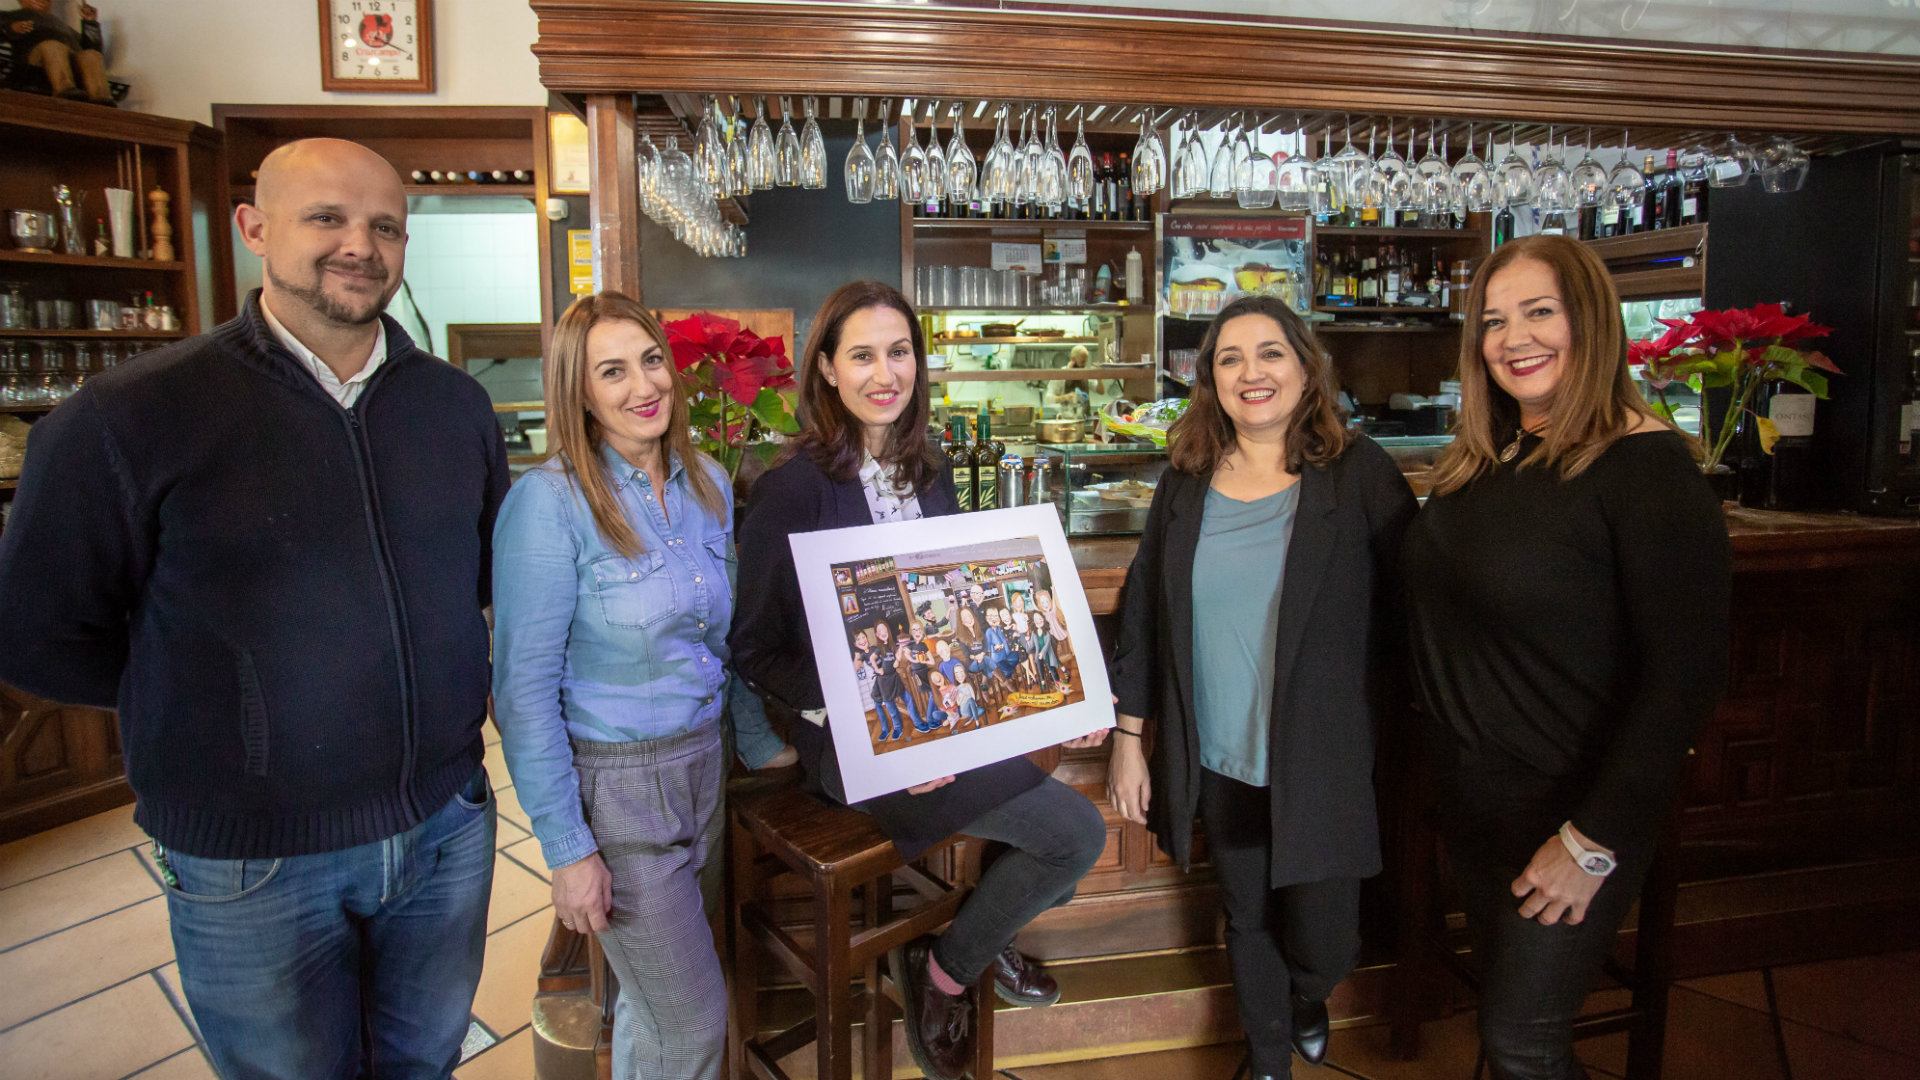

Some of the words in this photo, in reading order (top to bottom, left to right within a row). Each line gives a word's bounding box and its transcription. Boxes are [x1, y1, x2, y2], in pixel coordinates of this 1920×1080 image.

[352, 2, 361, 11] 11
[369, 2, 381, 11] 12
[338, 15, 350, 24] 10
[405, 16, 411, 25] 2
[407, 34, 412, 43] 3
[342, 52, 349, 61] 8
[357, 65, 363, 74] 7
[374, 67, 381, 76] 6
[393, 66, 399, 75] 5
